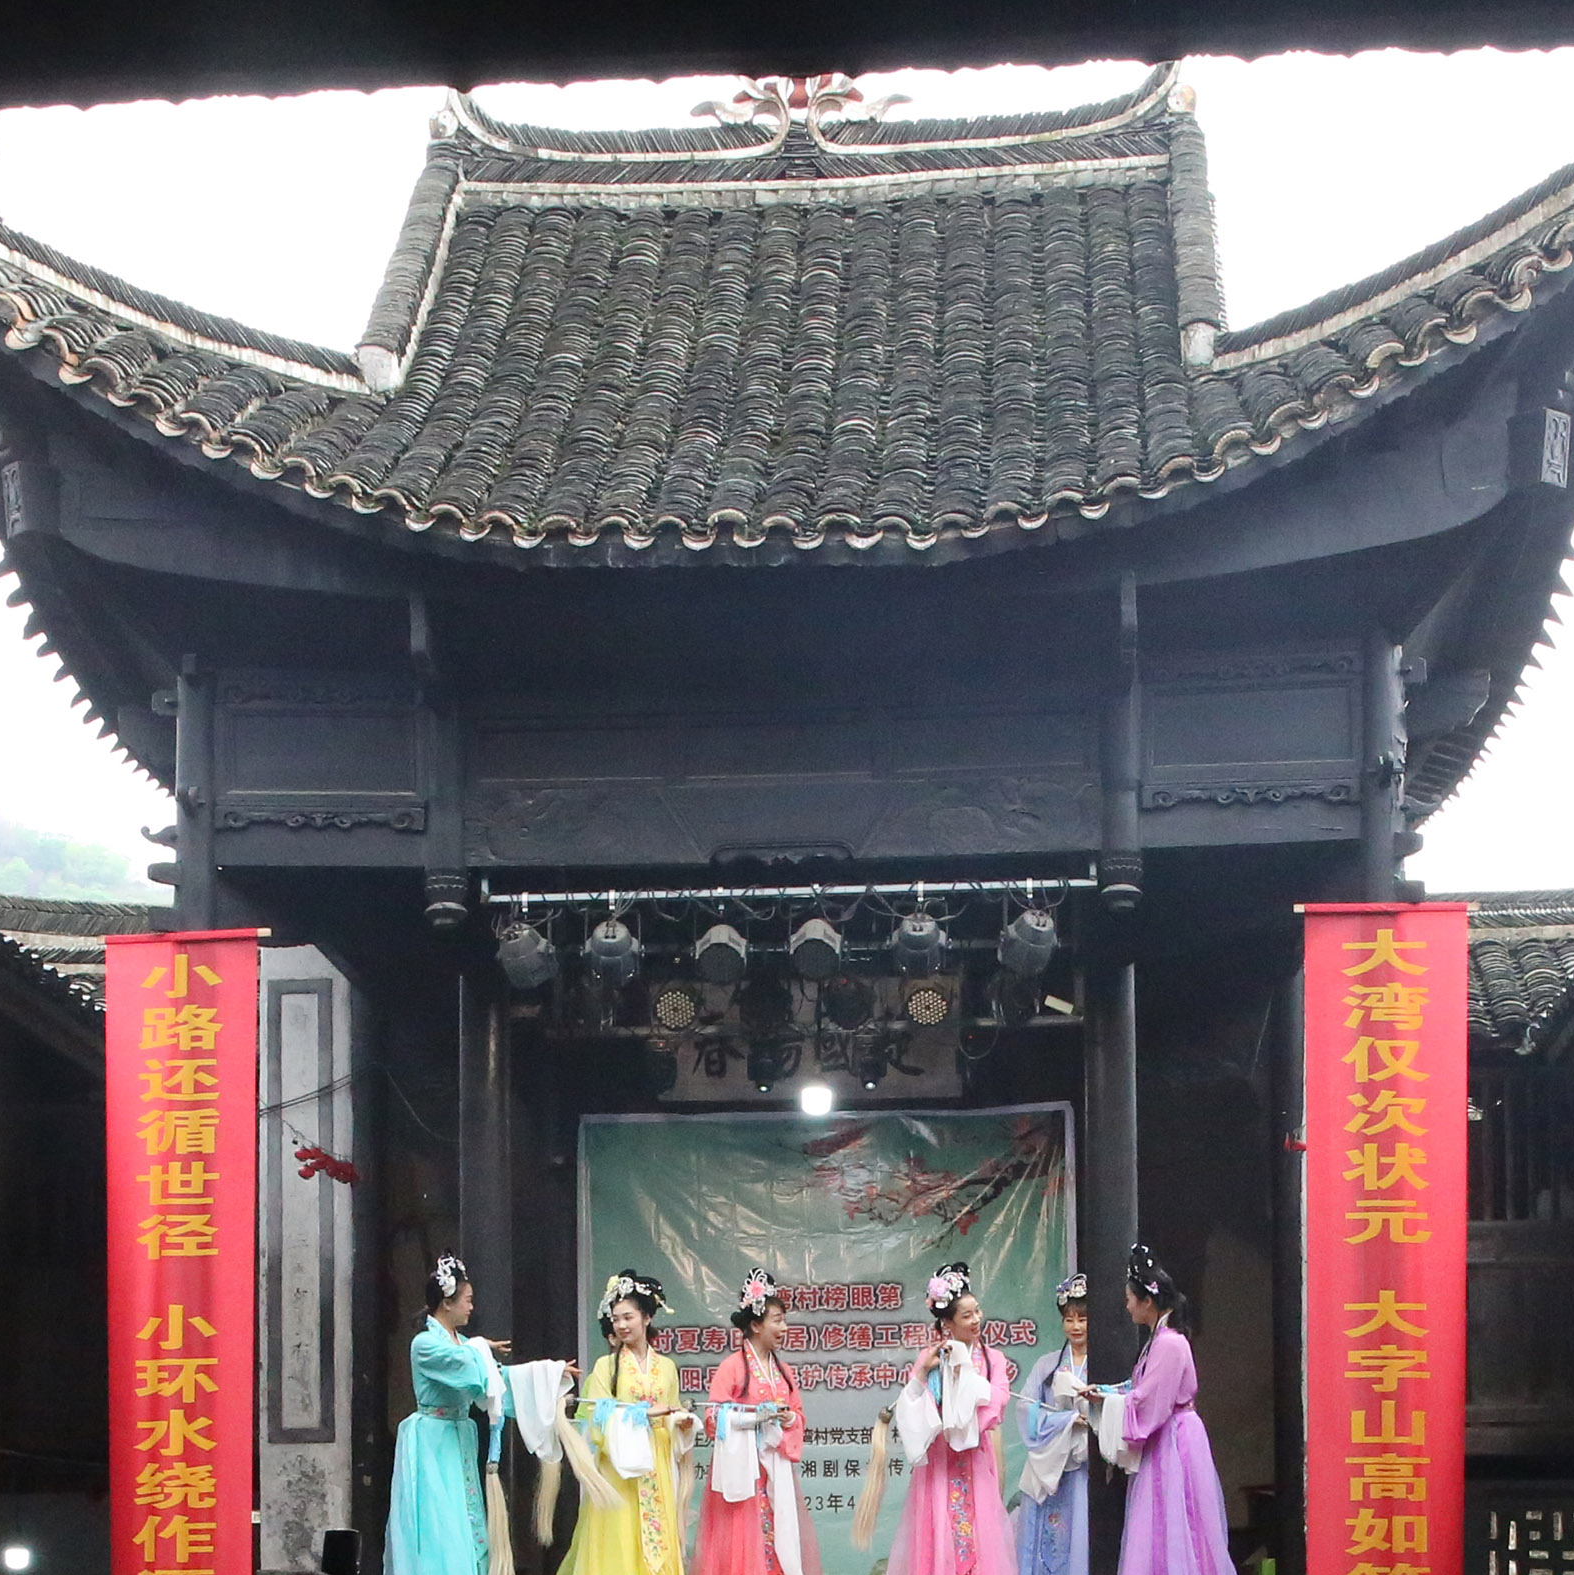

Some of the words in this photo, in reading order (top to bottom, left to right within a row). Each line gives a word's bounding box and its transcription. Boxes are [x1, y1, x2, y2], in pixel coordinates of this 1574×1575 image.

[136, 954, 223, 1260] 小路还循世径
[1341, 928, 1432, 1245] 大湾仅次状元
